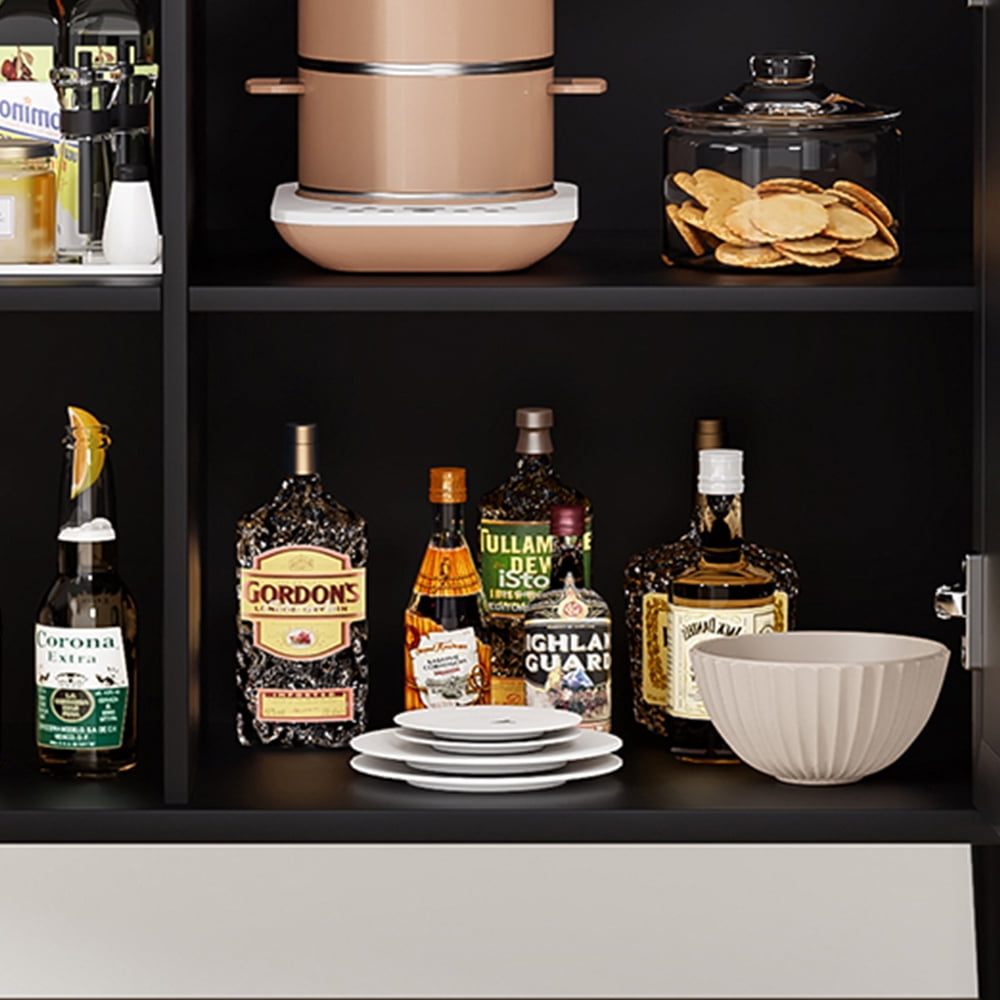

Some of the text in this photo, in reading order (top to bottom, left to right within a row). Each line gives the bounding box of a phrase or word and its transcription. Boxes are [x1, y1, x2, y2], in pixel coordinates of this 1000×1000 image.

[245, 580, 361, 606] GORDON'S
[36, 629, 115, 650] Corona
[47, 649, 97, 664] Extra
